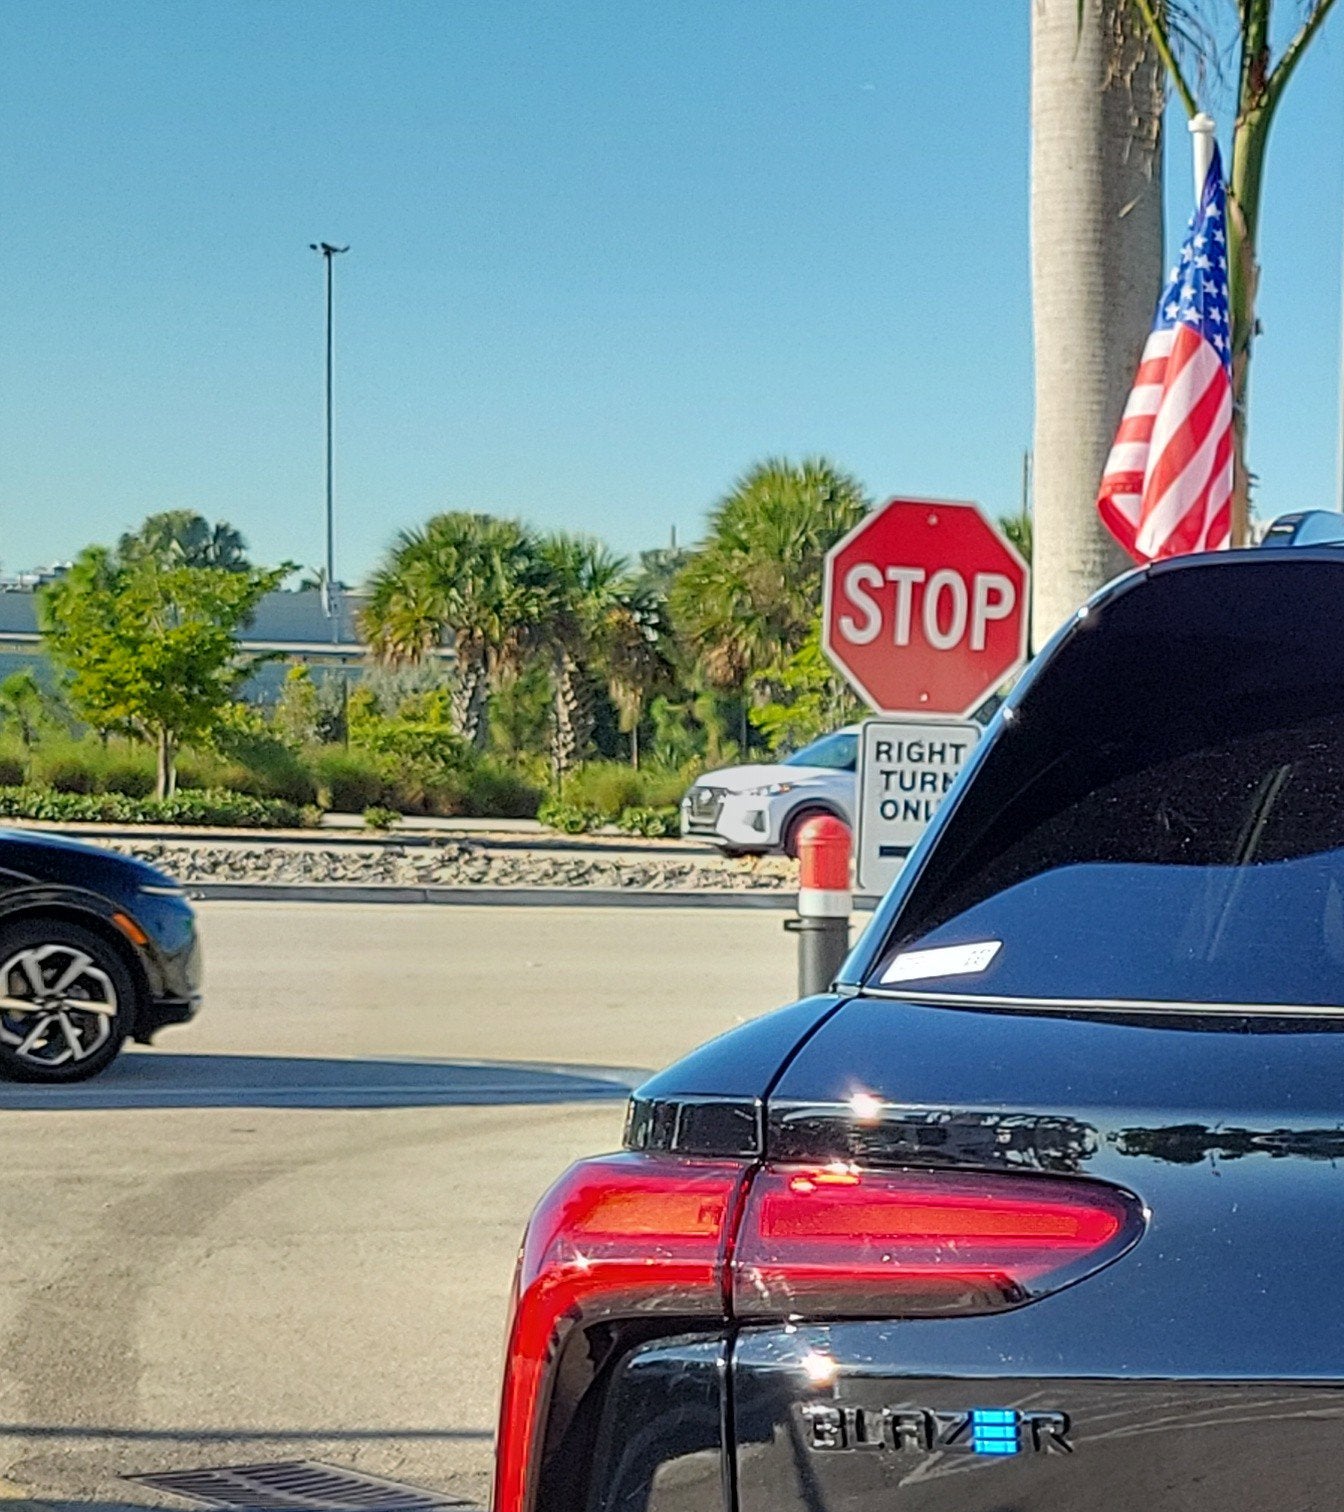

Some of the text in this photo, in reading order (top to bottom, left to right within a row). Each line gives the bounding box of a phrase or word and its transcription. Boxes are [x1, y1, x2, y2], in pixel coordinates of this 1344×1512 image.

[838, 562, 1016, 652] STOP
[876, 740, 967, 764] RIGHT
[880, 799, 937, 823] ONL
[802, 1405, 1074, 1455] BLAZER
